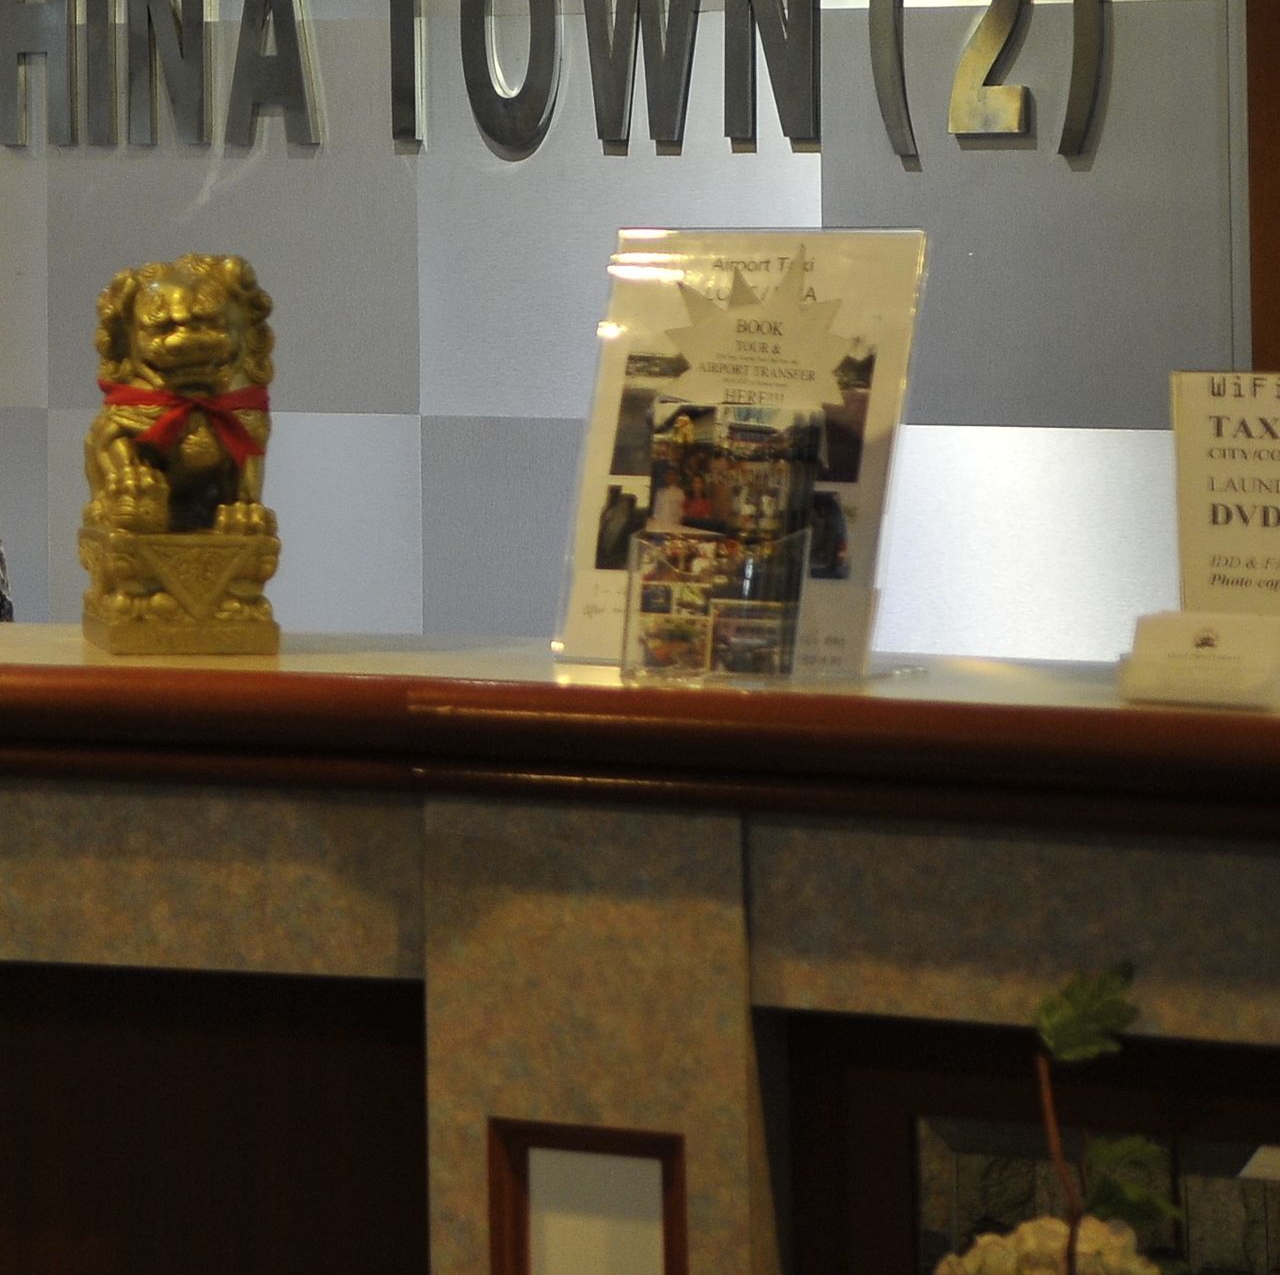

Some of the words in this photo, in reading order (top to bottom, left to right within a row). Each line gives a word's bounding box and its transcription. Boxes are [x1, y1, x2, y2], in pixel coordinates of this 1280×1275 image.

[713, 257, 771, 272] Airport
[735, 318, 784, 336] BOOK
[735, 340, 769, 354] TOUR
[771, 342, 782, 355] &
[697, 361, 750, 376] AIRPORT
[753, 364, 817, 382] TRANSFER
[1210, 502, 1280, 528] DVD
[1209, 573, 1253, 587] Photo
